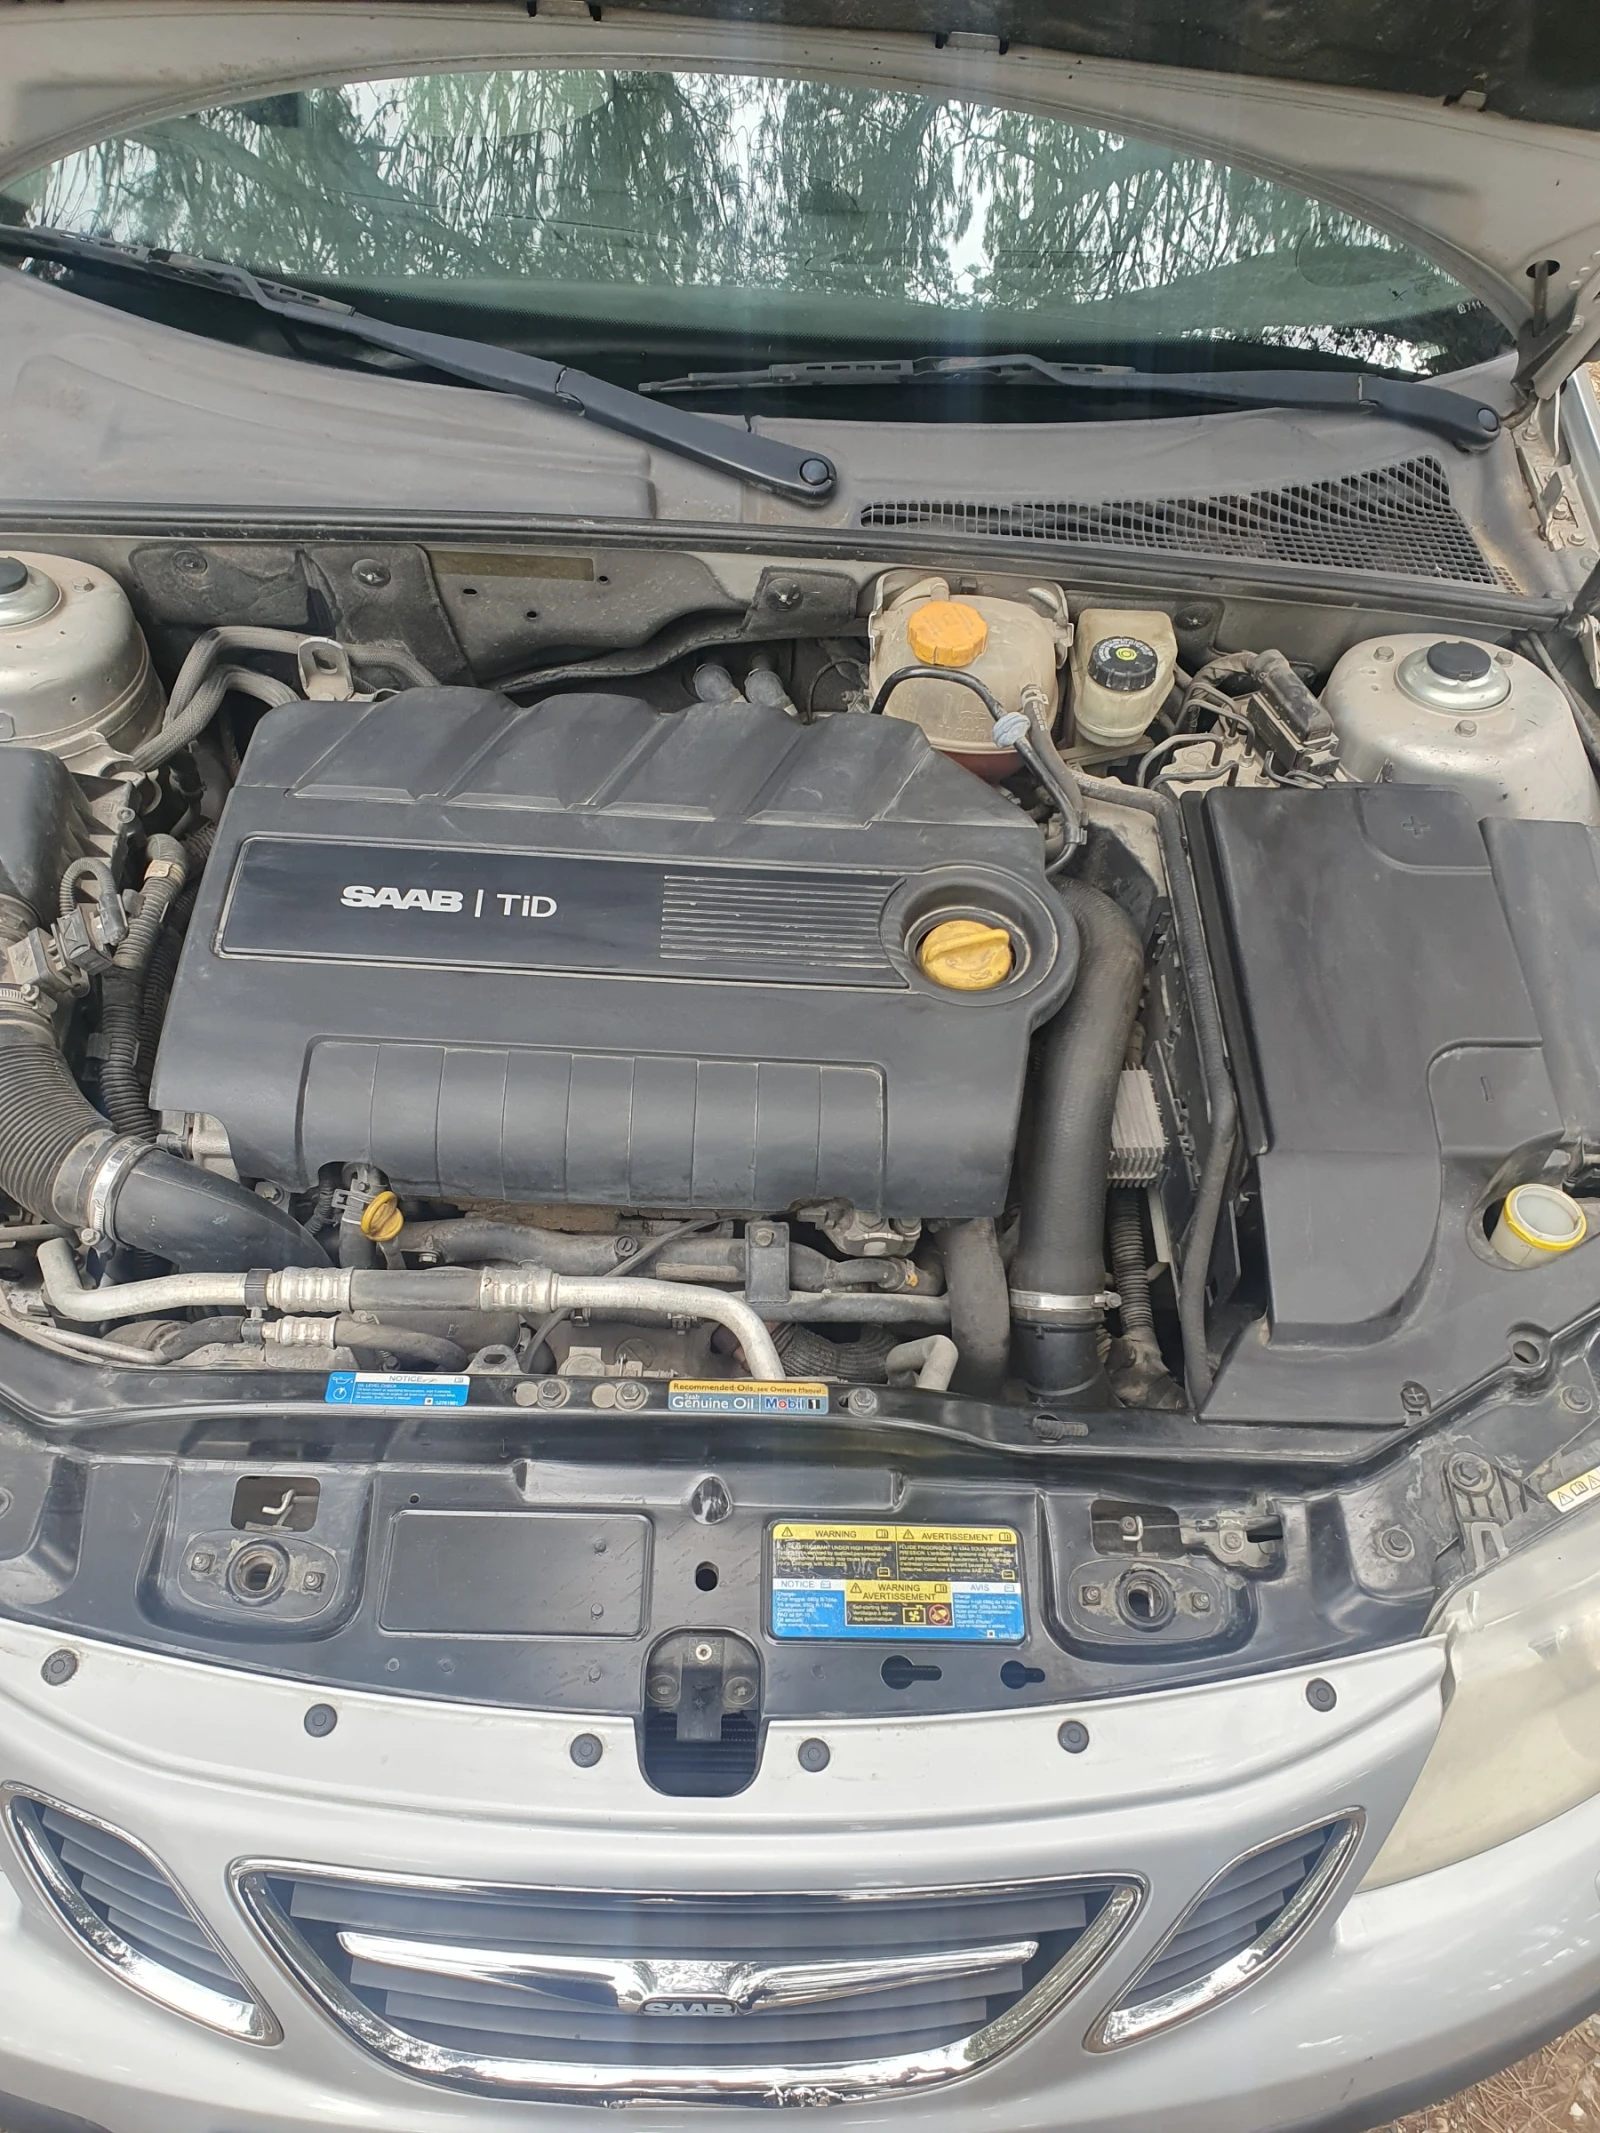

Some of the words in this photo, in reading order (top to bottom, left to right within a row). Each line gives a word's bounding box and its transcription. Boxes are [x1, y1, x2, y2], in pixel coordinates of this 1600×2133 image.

[340, 885, 464, 912] SAAB
[496, 893, 558, 918] TiD
[673, 1382, 734, 1392] Recommended
[672, 1396, 729, 1409] Genuine
[733, 1397, 754, 1410] Oil
[765, 1397, 804, 1410] Mobil
[815, 1530, 856, 1538] WARNING
[921, 1532, 994, 1541] AVERTISSEMENT
[862, 1592, 936, 1600] AVERTISSEMENT
[642, 2002, 736, 2016] SAAB
